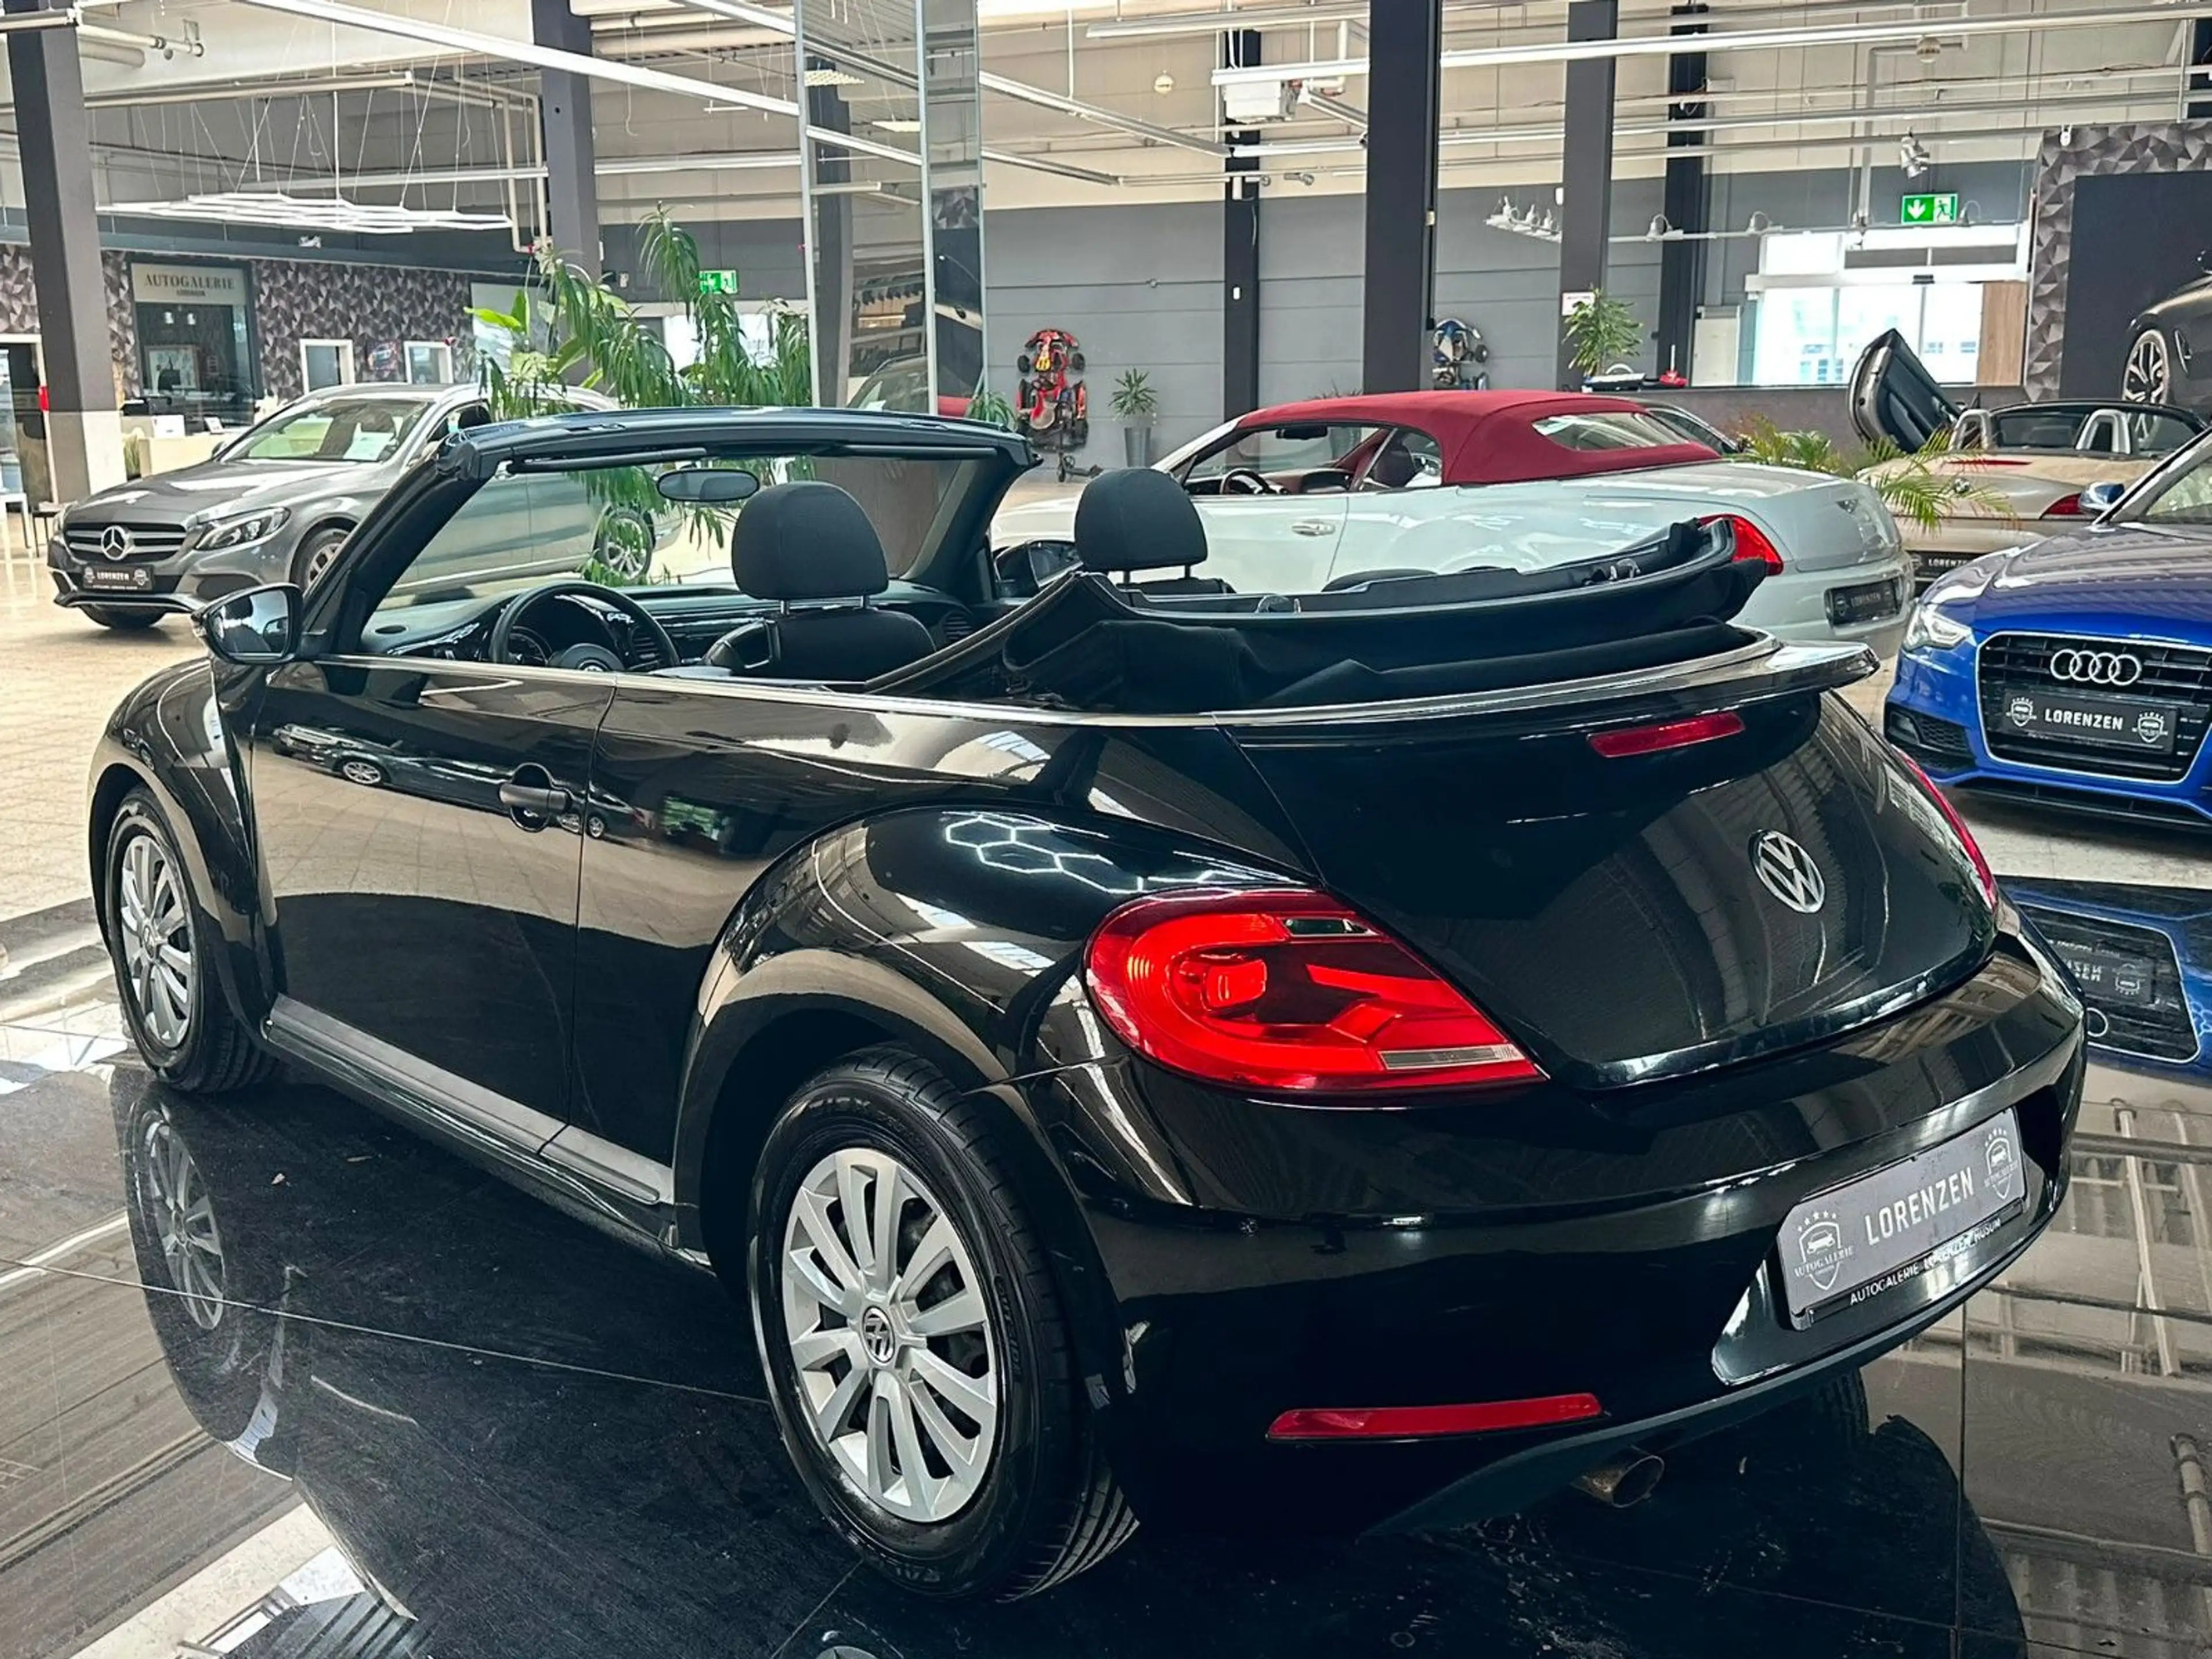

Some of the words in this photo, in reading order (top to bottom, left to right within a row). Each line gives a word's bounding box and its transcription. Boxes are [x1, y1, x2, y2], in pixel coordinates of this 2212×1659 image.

[145, 274, 234, 289] AUTOGALERIE
[2044, 707, 2124, 730] LORENZEN
[1864, 1166, 1975, 1245] LORENZEN
[1849, 1263, 1920, 1306] AUTOGALERIE
[1974, 1217, 2002, 1243] HUSUM
